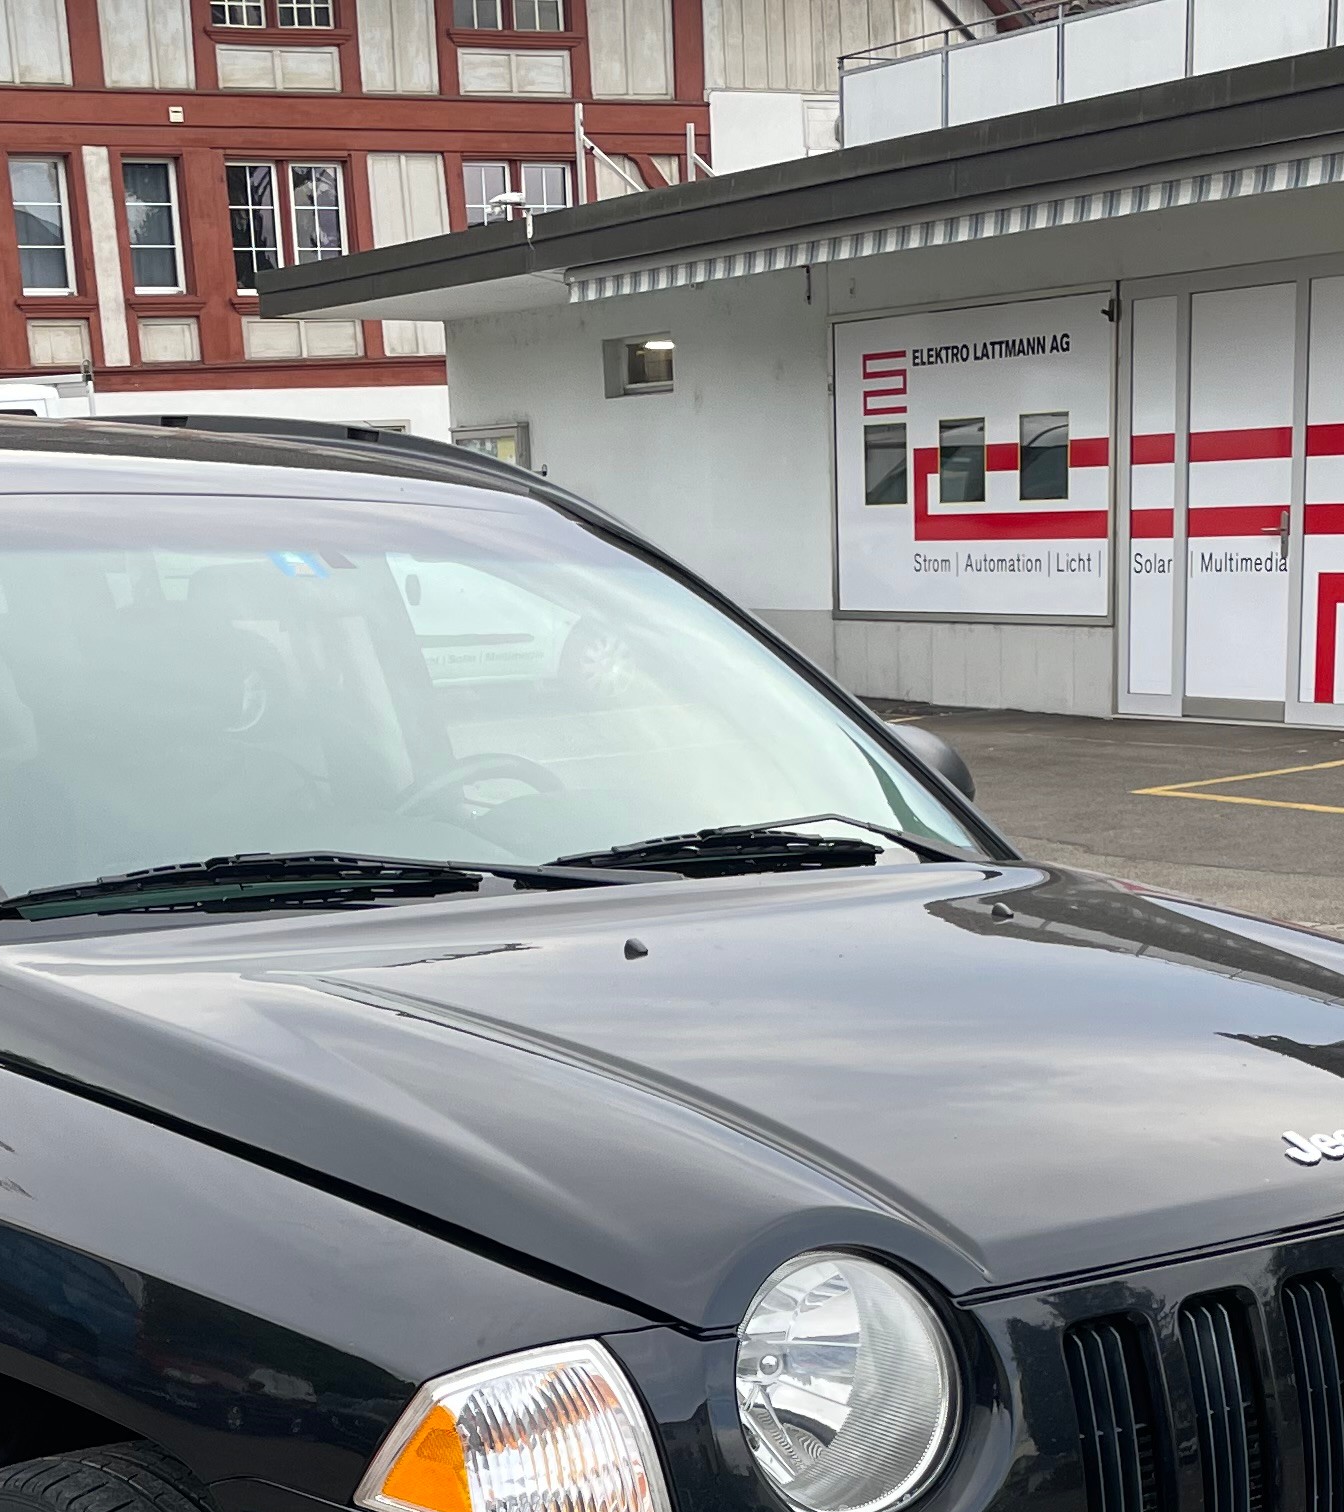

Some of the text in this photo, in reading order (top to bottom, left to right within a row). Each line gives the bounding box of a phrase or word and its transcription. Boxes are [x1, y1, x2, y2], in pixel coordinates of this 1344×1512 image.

[912, 333, 1071, 367] ELEKTRO LATTMANN AG
[913, 551, 1288, 574] Strom Automation Licht Solar Multimedia
